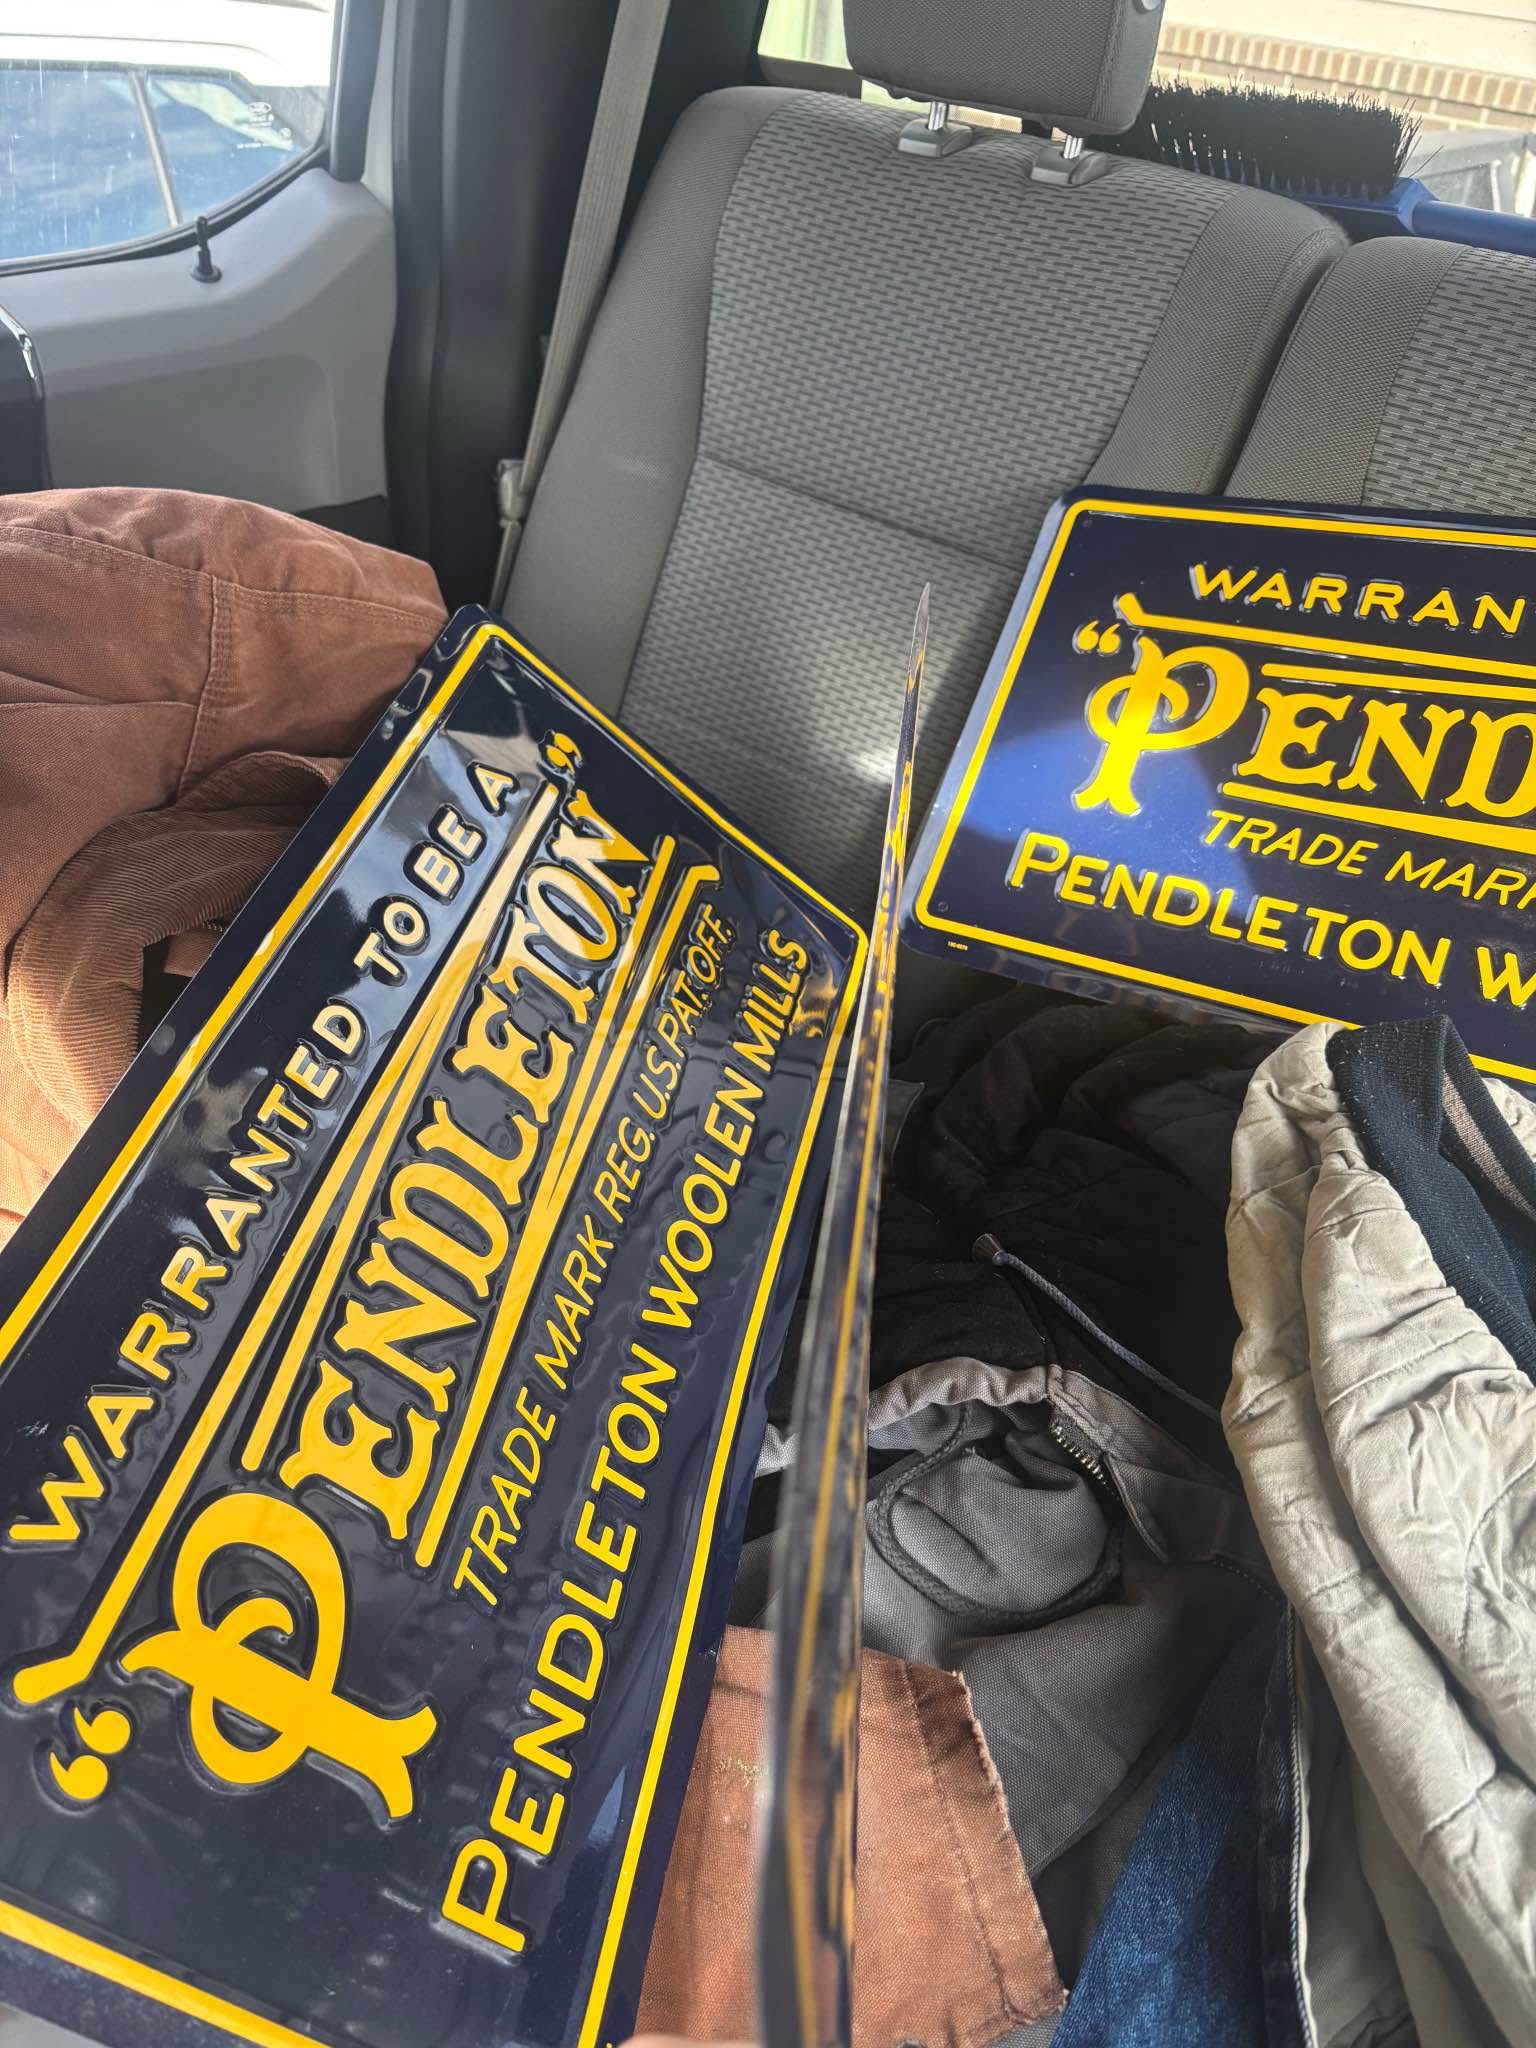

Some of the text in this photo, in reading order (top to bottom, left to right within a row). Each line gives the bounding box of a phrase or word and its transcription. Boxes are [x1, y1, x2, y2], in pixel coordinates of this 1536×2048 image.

[1193, 564, 1526, 634] WARRAN
[1010, 832, 1452, 987] PENDLETON
[1205, 810, 1379, 876] TRADE
[9, 766, 514, 1542] WARRANTED TO BE A
[453, 1386, 556, 1606] TRADE
[534, 1215, 614, 1389] MARK
[593, 1116, 656, 1223] REG.
[687, 903, 733, 983] OFF.
[441, 929, 808, 1954] PENDLETON WOOLEN MILLS
